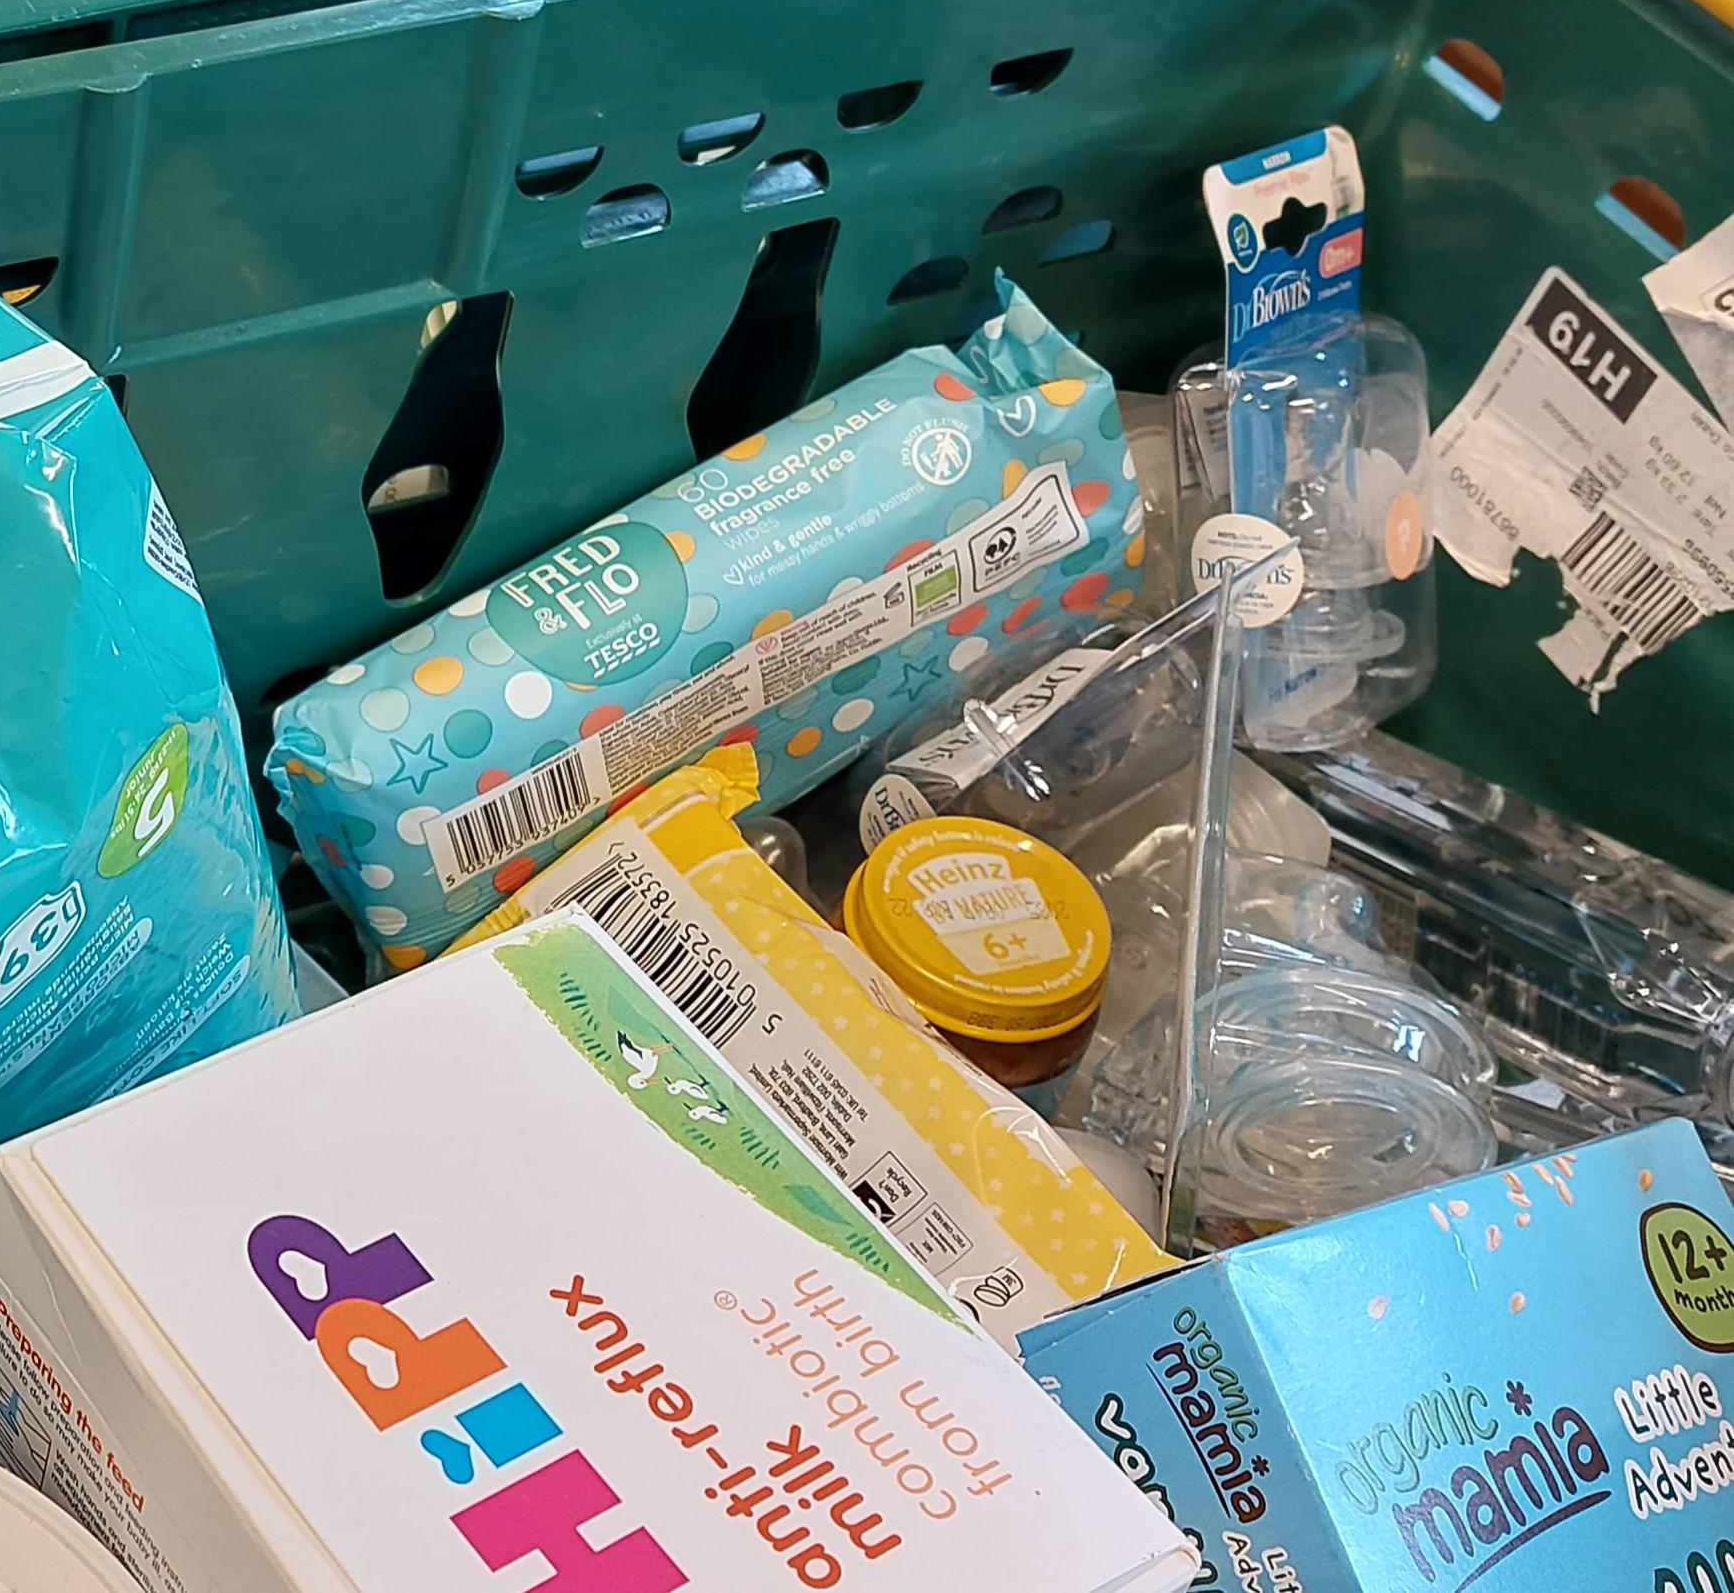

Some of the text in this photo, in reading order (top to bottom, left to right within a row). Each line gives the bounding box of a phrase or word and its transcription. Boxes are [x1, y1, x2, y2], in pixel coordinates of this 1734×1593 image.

[1548, 310, 1631, 403] H19
[677, 469, 728, 503] 60
[694, 397, 897, 521] BIODEGRADABLE
[710, 448, 857, 537] fragrance free
[501, 535, 621, 607] FRED
[724, 516, 781, 551] wipes
[740, 513, 833, 572] kind & gentle
[748, 571, 766, 587] for
[768, 548, 802, 581] messy
[802, 532, 835, 557] hands
[534, 563, 640, 635] & FLO
[584, 622, 658, 670] TESCO
[134, 767, 175, 858] 5
[916, 859, 1004, 893] Heinz
[0, 910, 58, 985] 39
[616, 852, 784, 1035] 5 010525 183572
[982, 931, 1028, 959] 6+
[877, 1179, 900, 1204] Don't
[887, 1167, 913, 1197] Recycle
[1658, 1229, 1728, 1284] 12+
[1674, 1287, 1734, 1314] month
[793, 1267, 901, 1371] birth
[713, 1289, 958, 1523] combiotic®
[1174, 1305, 1260, 1444] organic
[1616, 1368, 1716, 1436] Little
[18, 1371, 28, 1387] to
[29, 1387, 42, 1406] do
[42, 1407, 54, 1425] so
[55, 1424, 76, 1454] may
[76, 1453, 103, 1493] make
[104, 1492, 125, 1523] your
[22, 1360, 50, 1399] follow
[50, 1400, 104, 1477] preparation
[104, 1477, 124, 1507] and
[56, 1449, 80, 1489] Wash
[76, 1409, 103, 1455] the
[106, 1451, 145, 1513] feed
[548, 1272, 843, 1591] anti-reflux
[899, 1378, 1013, 1501] from
[1152, 1341, 1268, 1525] mamia
[1335, 1372, 1500, 1514] organic
[764, 1424, 904, 1560] milk
[1393, 1406, 1610, 1583] mamia
